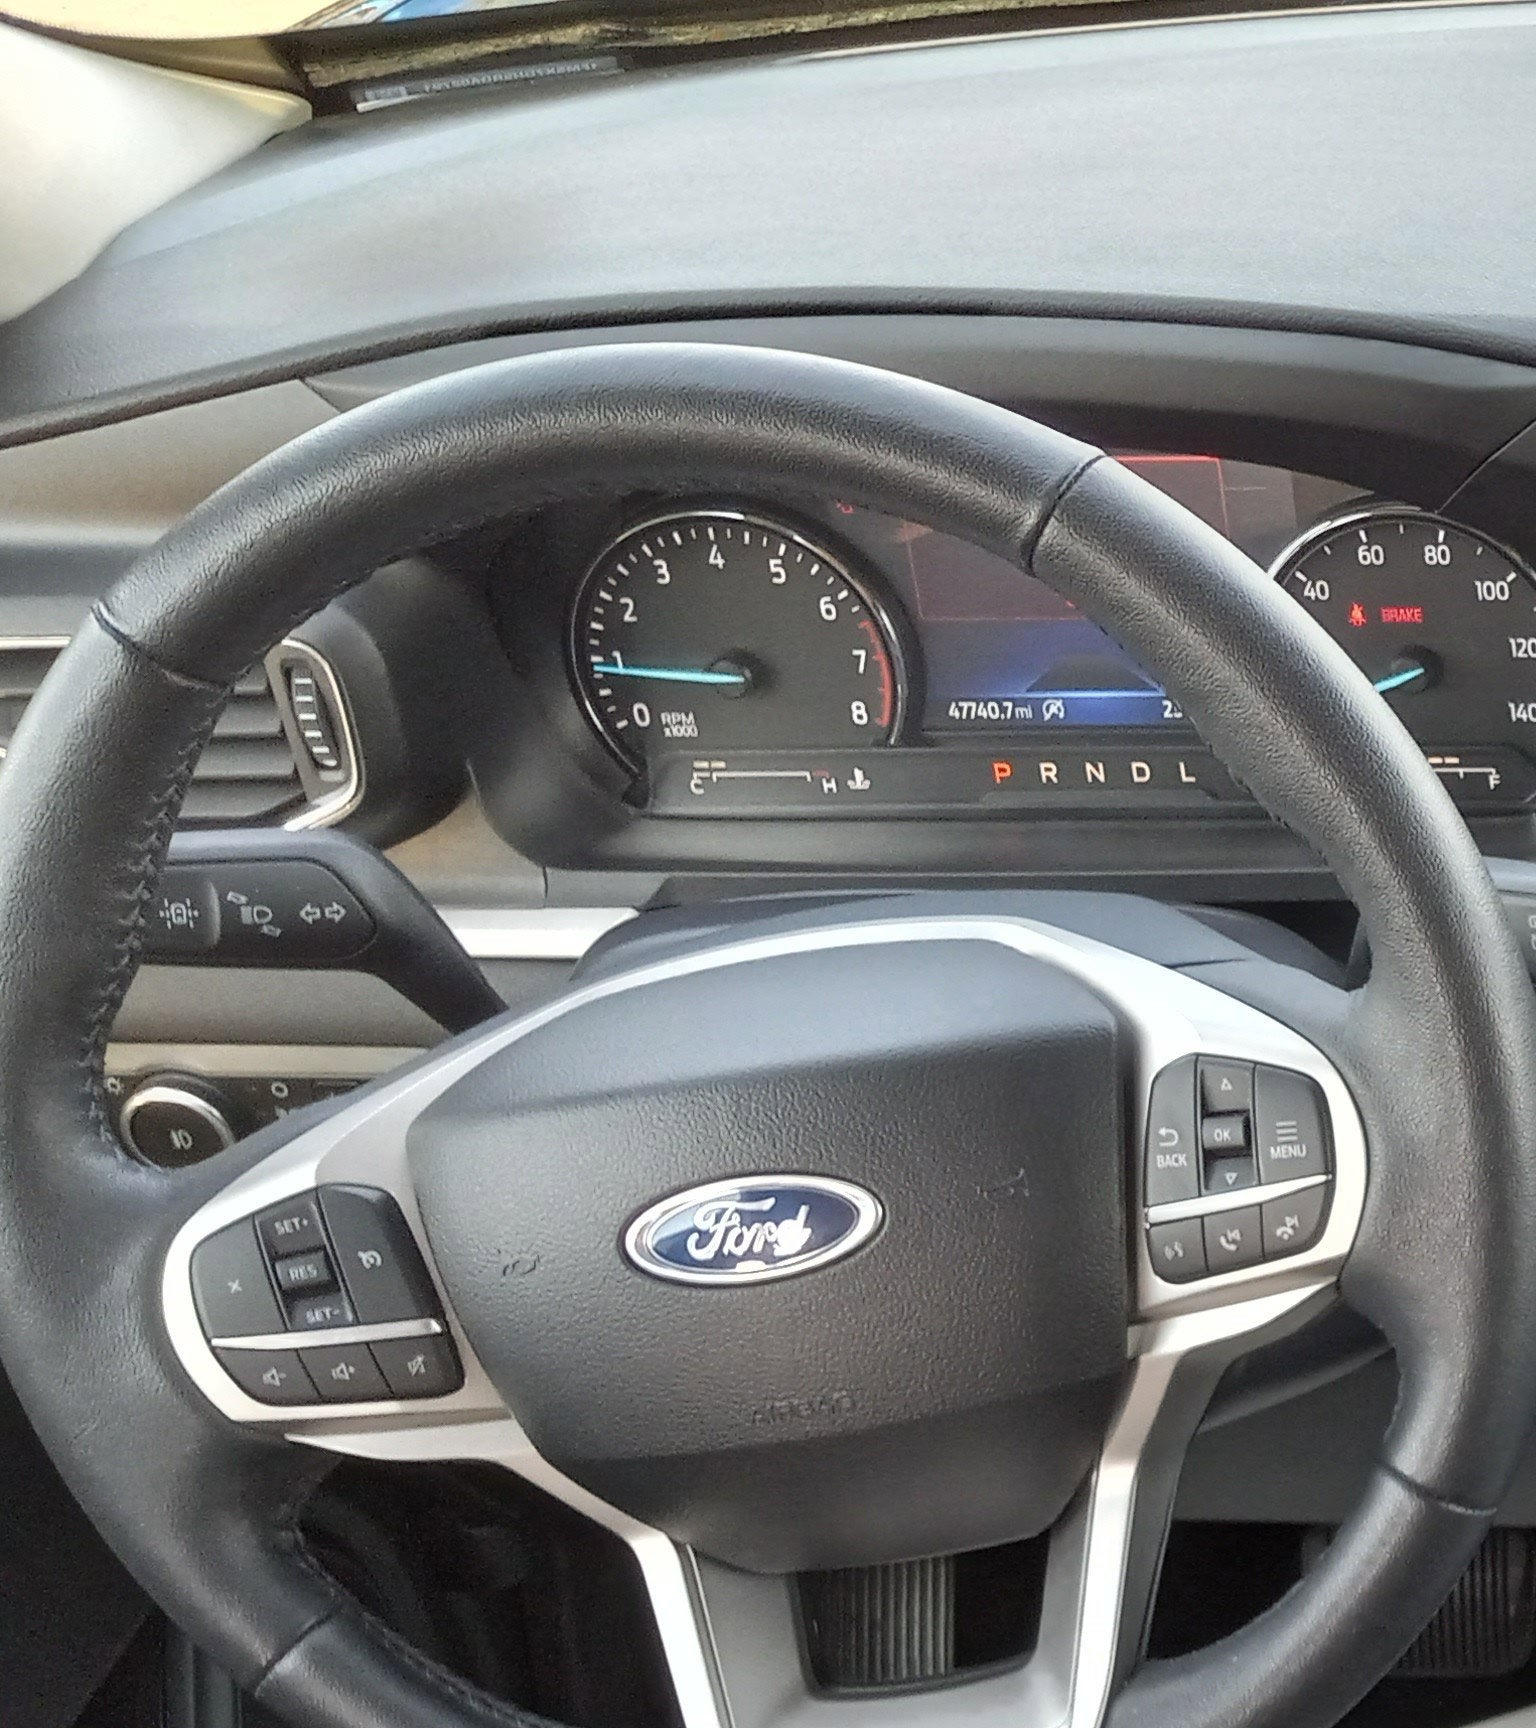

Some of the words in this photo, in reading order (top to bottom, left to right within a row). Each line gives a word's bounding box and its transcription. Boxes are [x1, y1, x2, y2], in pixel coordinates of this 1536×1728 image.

[708, 544, 726, 570] 4
[1358, 545, 1384, 566] 60
[1424, 545, 1451, 566] 80
[655, 560, 671, 584] 3
[768, 560, 786, 584] 5
[1303, 580, 1330, 600] 40
[1475, 580, 1509, 601] 100
[619, 598, 638, 622] 2
[819, 598, 837, 621] 6
[1381, 606, 1423, 623] BRAKE
[852, 649, 867, 673] 7
[632, 703, 651, 727] 0
[660, 711, 695, 726] RPM
[851, 701, 868, 725] 8
[992, 761, 1012, 784] P
[1039, 762, 1058, 784] R
[1085, 762, 1105, 783] N
[1131, 761, 1150, 783] D
[1179, 761, 1196, 783] L
[690, 779, 705, 795] C
[821, 777, 838, 794] H
[1213, 1129, 1231, 1142] OK
[1156, 1153, 1188, 1169] BACK
[1269, 1144, 1307, 1160] MENU
[686, 1197, 812, 1261] Ford
